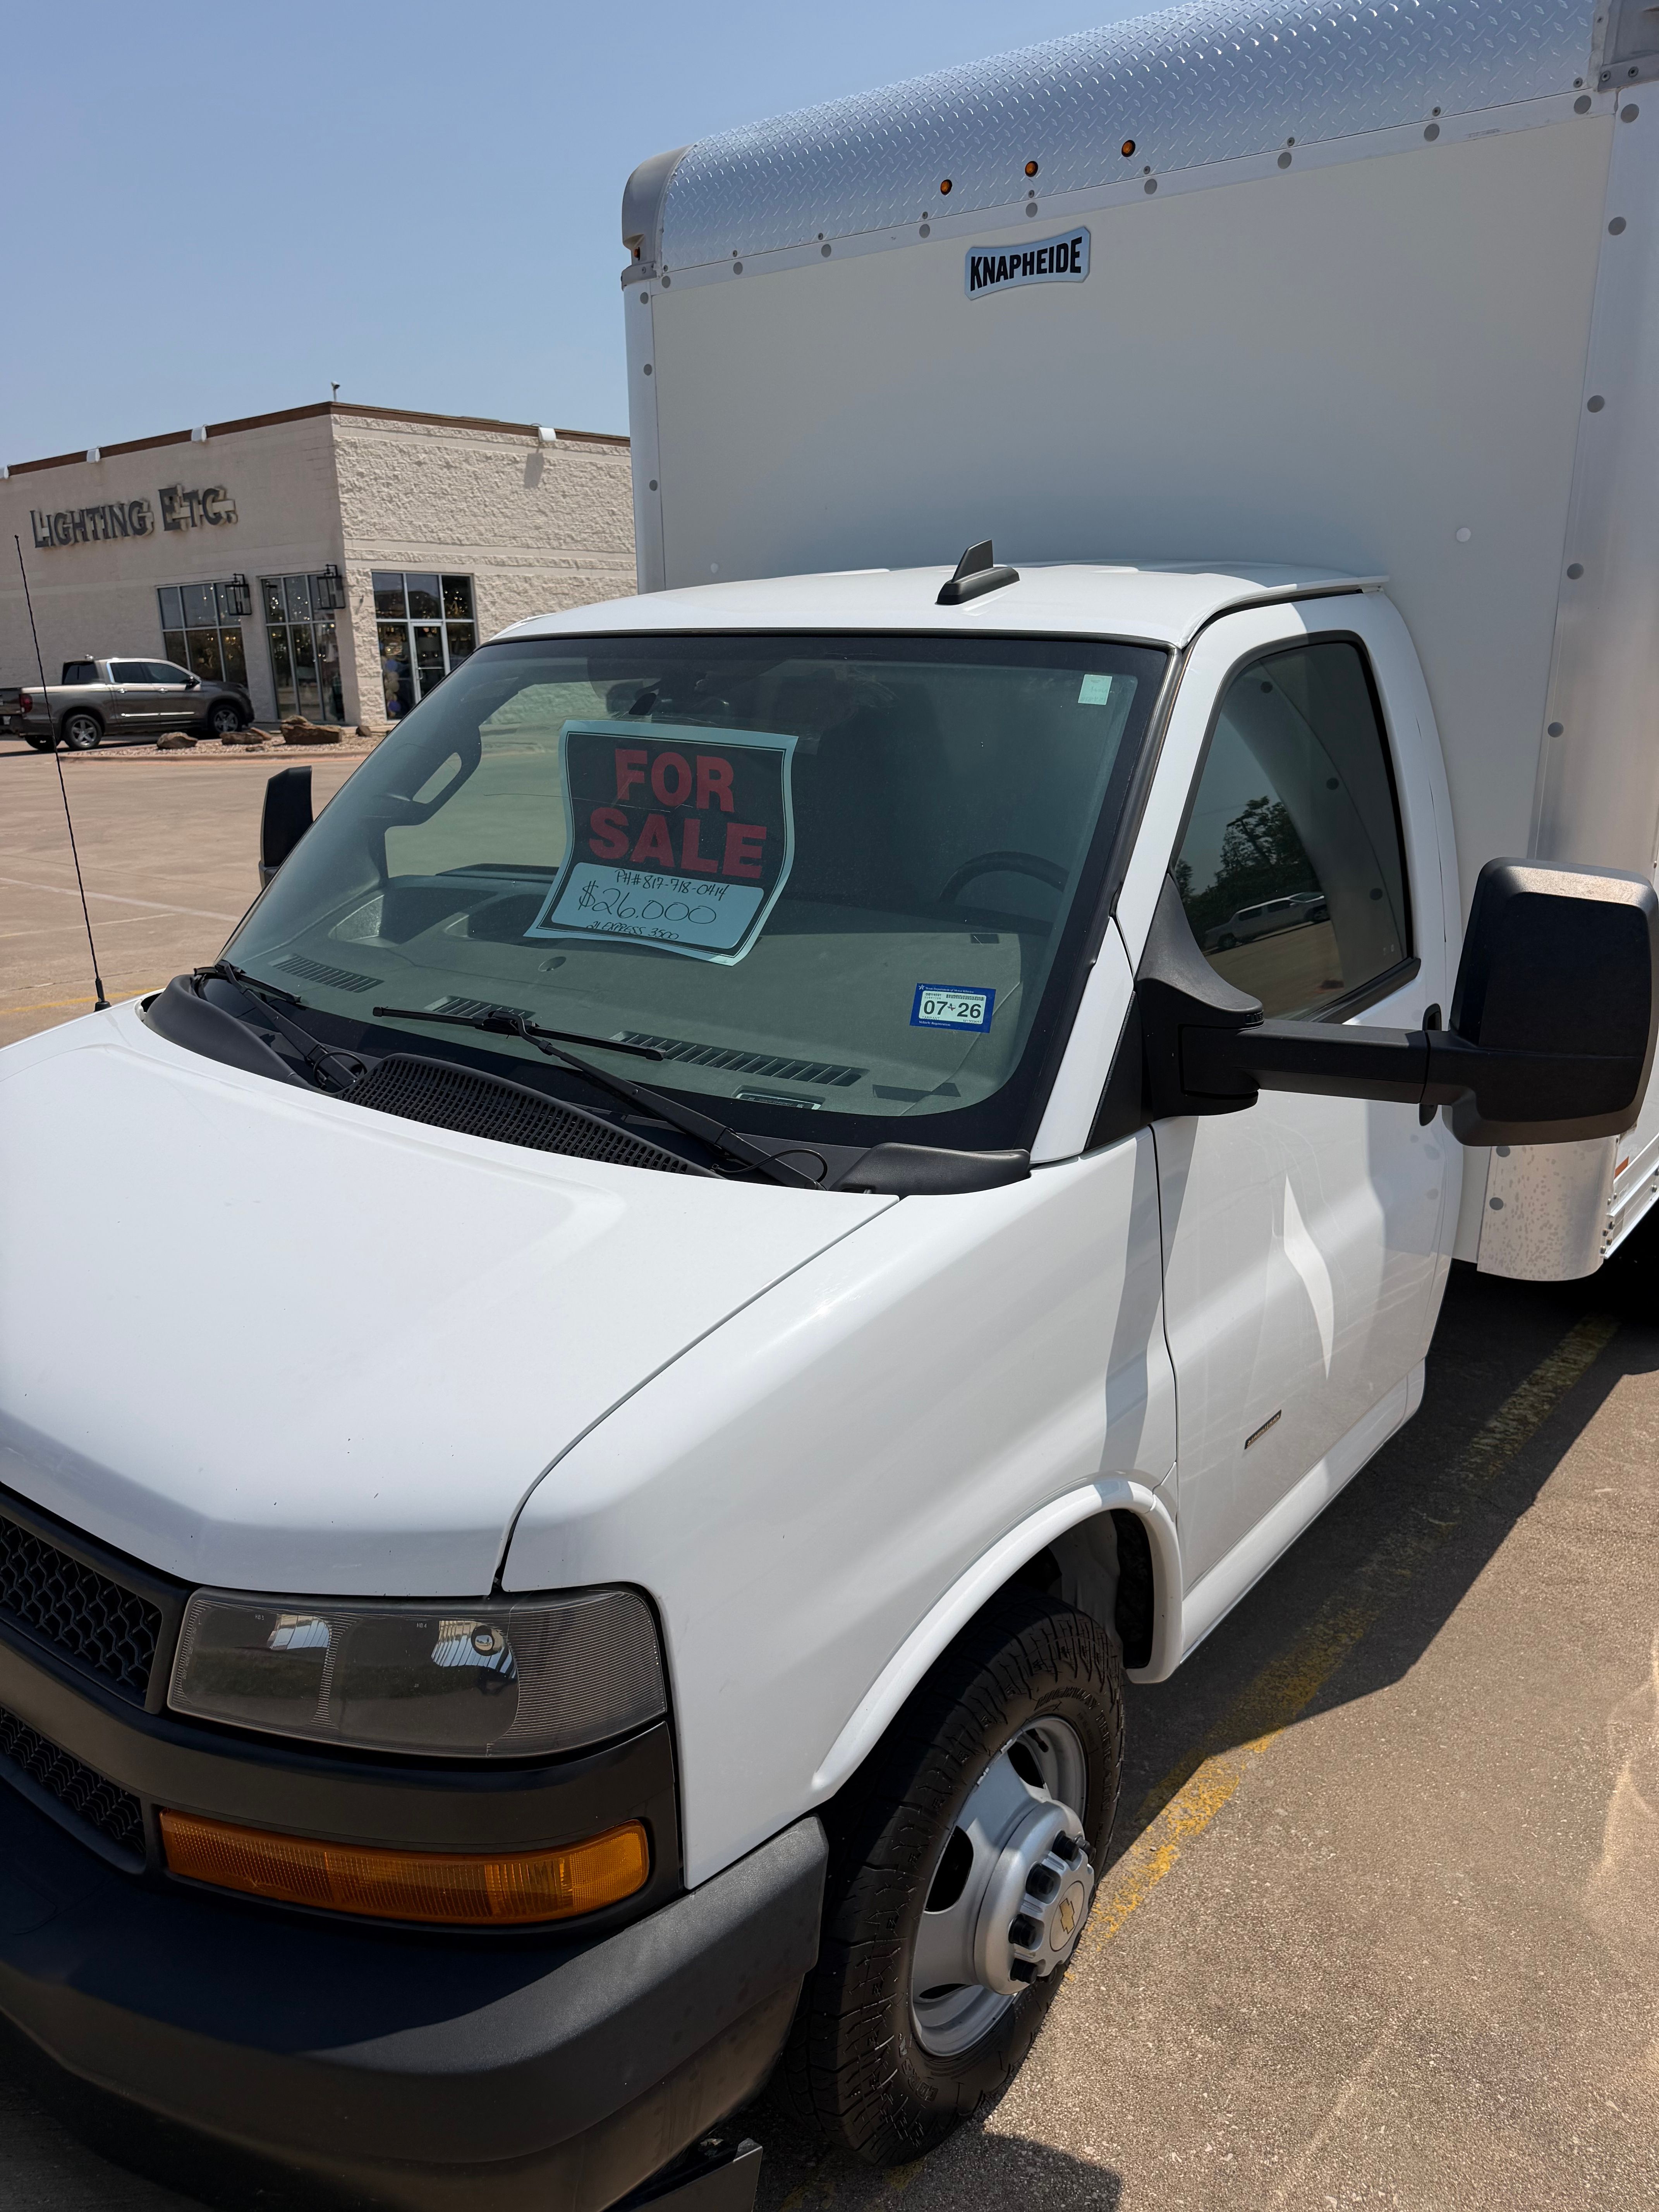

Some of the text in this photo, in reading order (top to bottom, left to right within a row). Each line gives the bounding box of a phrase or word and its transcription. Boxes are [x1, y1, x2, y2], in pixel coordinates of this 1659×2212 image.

[970, 236, 1082, 291] KNAPHEIDE
[30, 500, 153, 548] LIGHTING
[615, 748, 735, 812] FOR
[588, 807, 767, 879] SALE
[578, 880, 717, 924] $26,000
[602, 922, 646, 935] EXPRESS
[648, 928, 679, 940] 3500
[924, 1000, 981, 1018] 07 26
